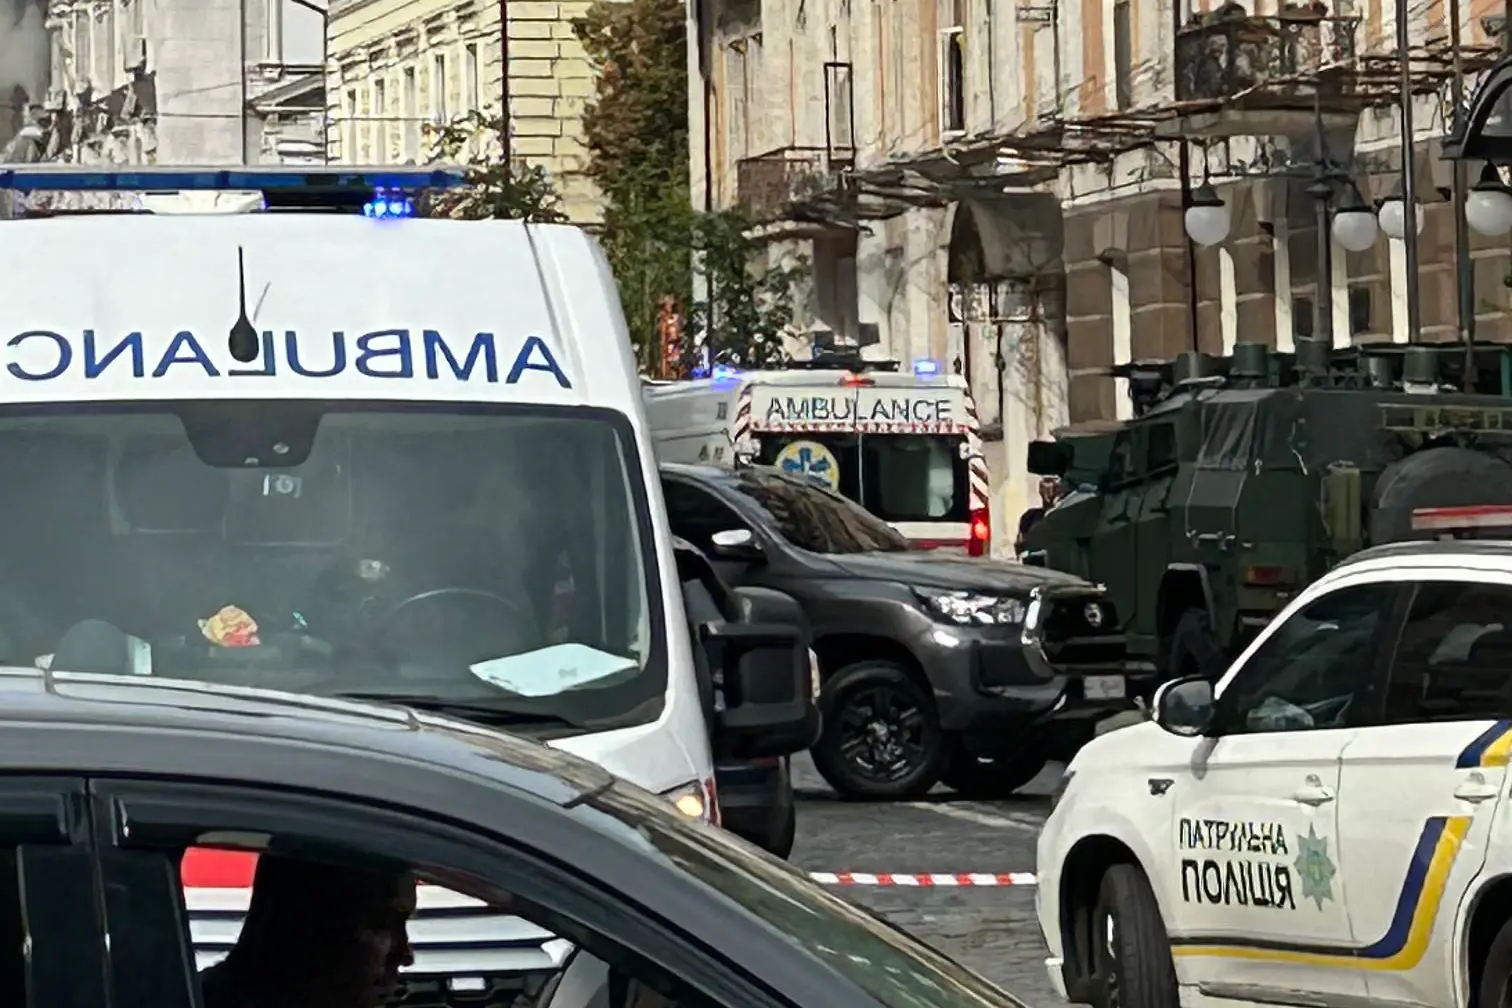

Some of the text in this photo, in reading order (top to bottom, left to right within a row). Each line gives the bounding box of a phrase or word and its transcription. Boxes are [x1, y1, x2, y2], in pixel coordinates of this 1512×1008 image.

[766, 396, 953, 422] AMBULANCE
[1179, 818, 1288, 854] ПАТРУЛЬНА
[1181, 859, 1296, 910] ПОЛІЦІЯ
